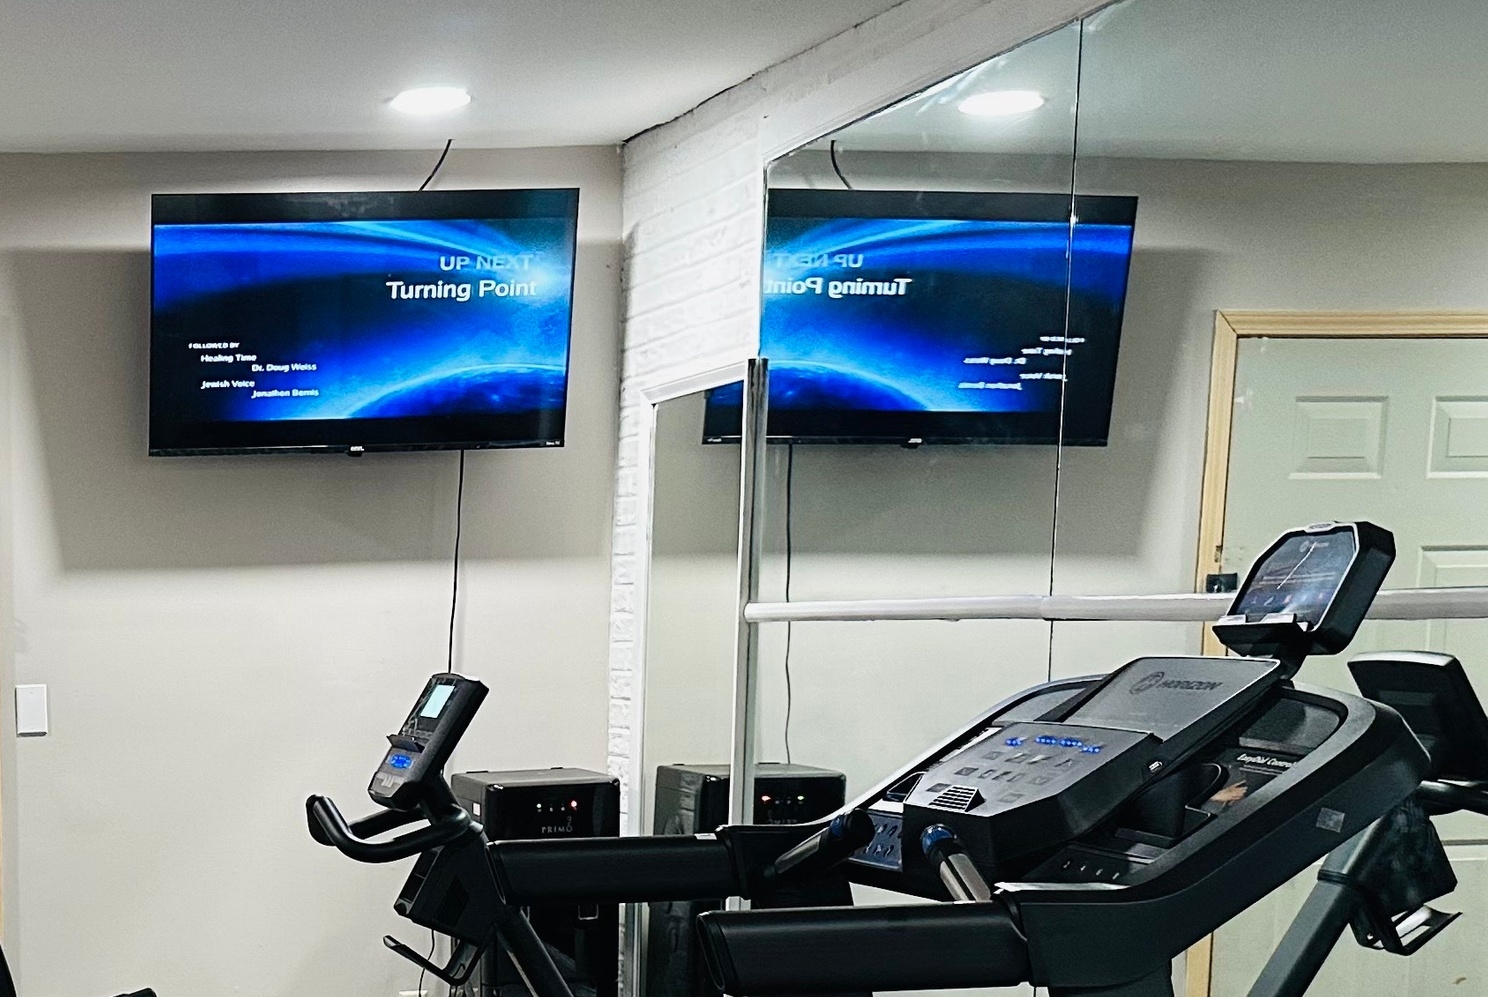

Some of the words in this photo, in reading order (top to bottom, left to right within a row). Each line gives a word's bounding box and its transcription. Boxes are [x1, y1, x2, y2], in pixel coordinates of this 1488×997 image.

[439, 255, 470, 271] UP
[475, 254, 534, 270] NEXT
[385, 280, 471, 302] Turning
[478, 279, 537, 298] Point
[200, 354, 234, 363] Healing
[235, 353, 257, 361] Time
[252, 364, 265, 372] Dr.
[266, 363, 290, 372] Doug
[291, 363, 317, 371] Weiss
[200, 380, 230, 389] Jewish
[231, 380, 255, 388] Voice
[541, 825, 573, 834] PRIMO
